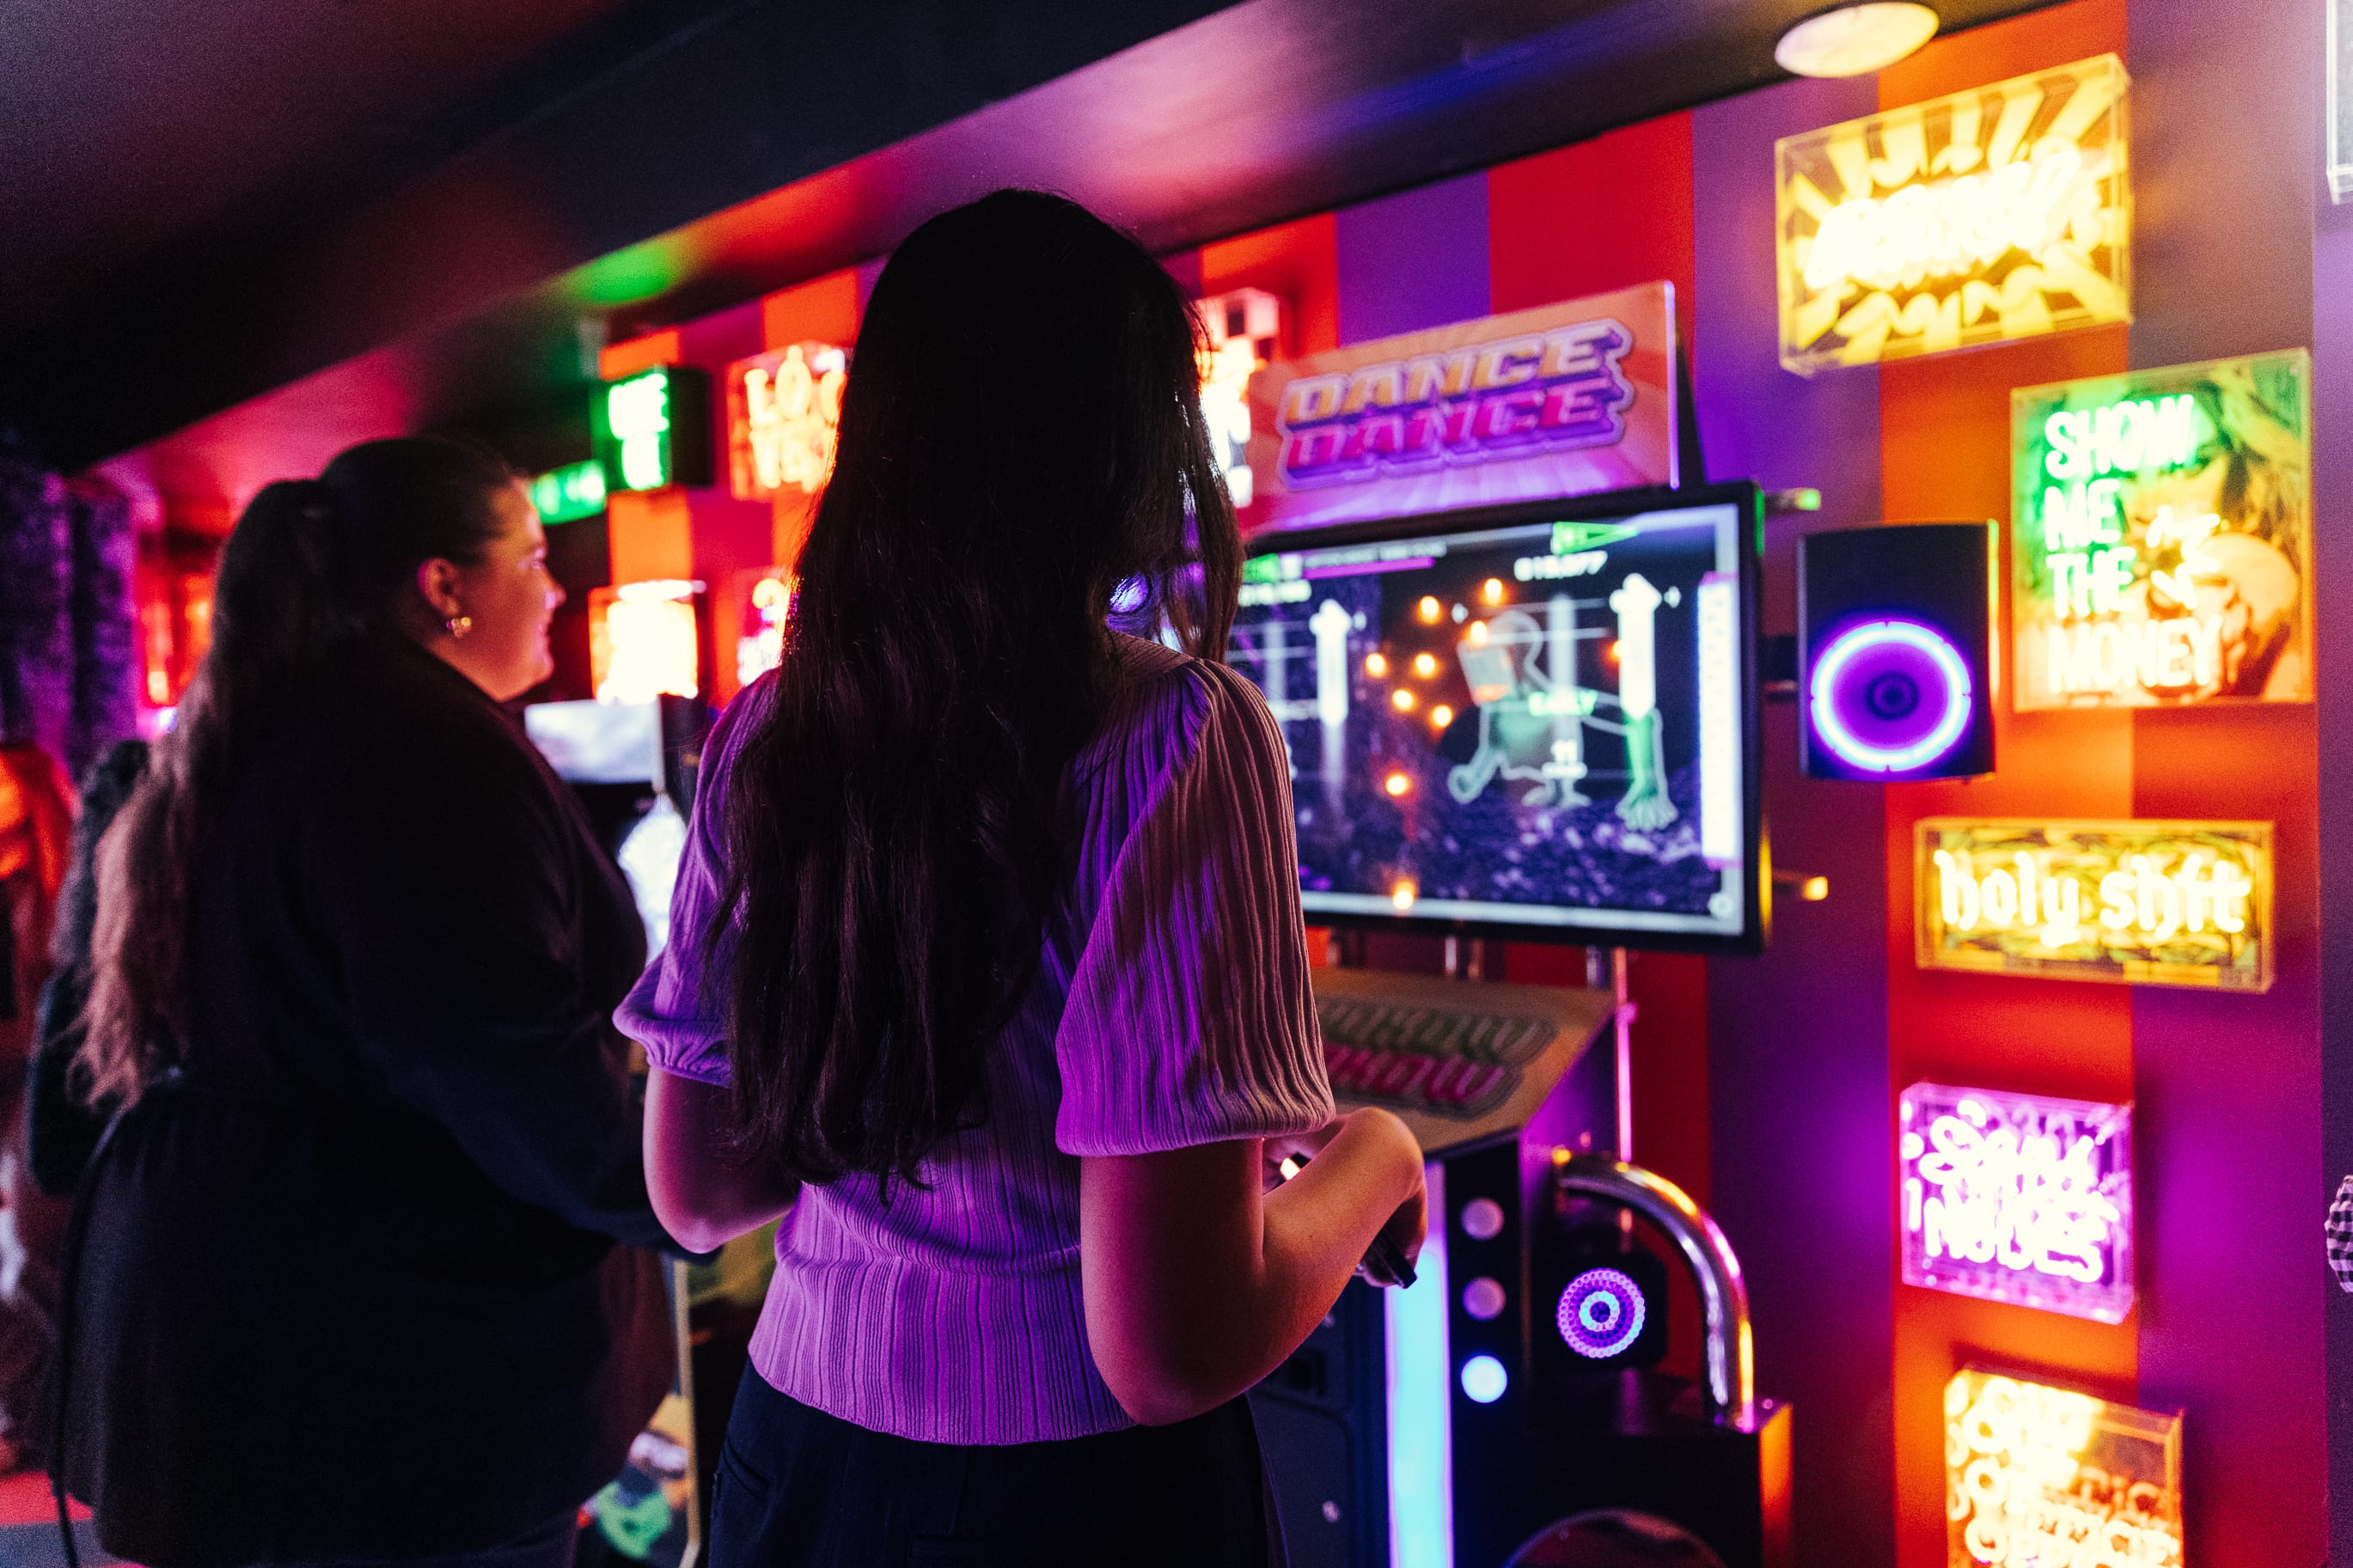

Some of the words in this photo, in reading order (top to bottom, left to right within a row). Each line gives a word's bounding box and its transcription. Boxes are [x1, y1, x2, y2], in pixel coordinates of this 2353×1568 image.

[1287, 323, 1621, 424] DANCE
[1287, 376, 1616, 471] DANCE
[2044, 394, 2194, 479] SHOW
[2044, 478, 2122, 552] ME
[2045, 546, 2136, 619] THE
[2047, 615, 2224, 694] MONEY
[1934, 849, 2081, 949] holy
